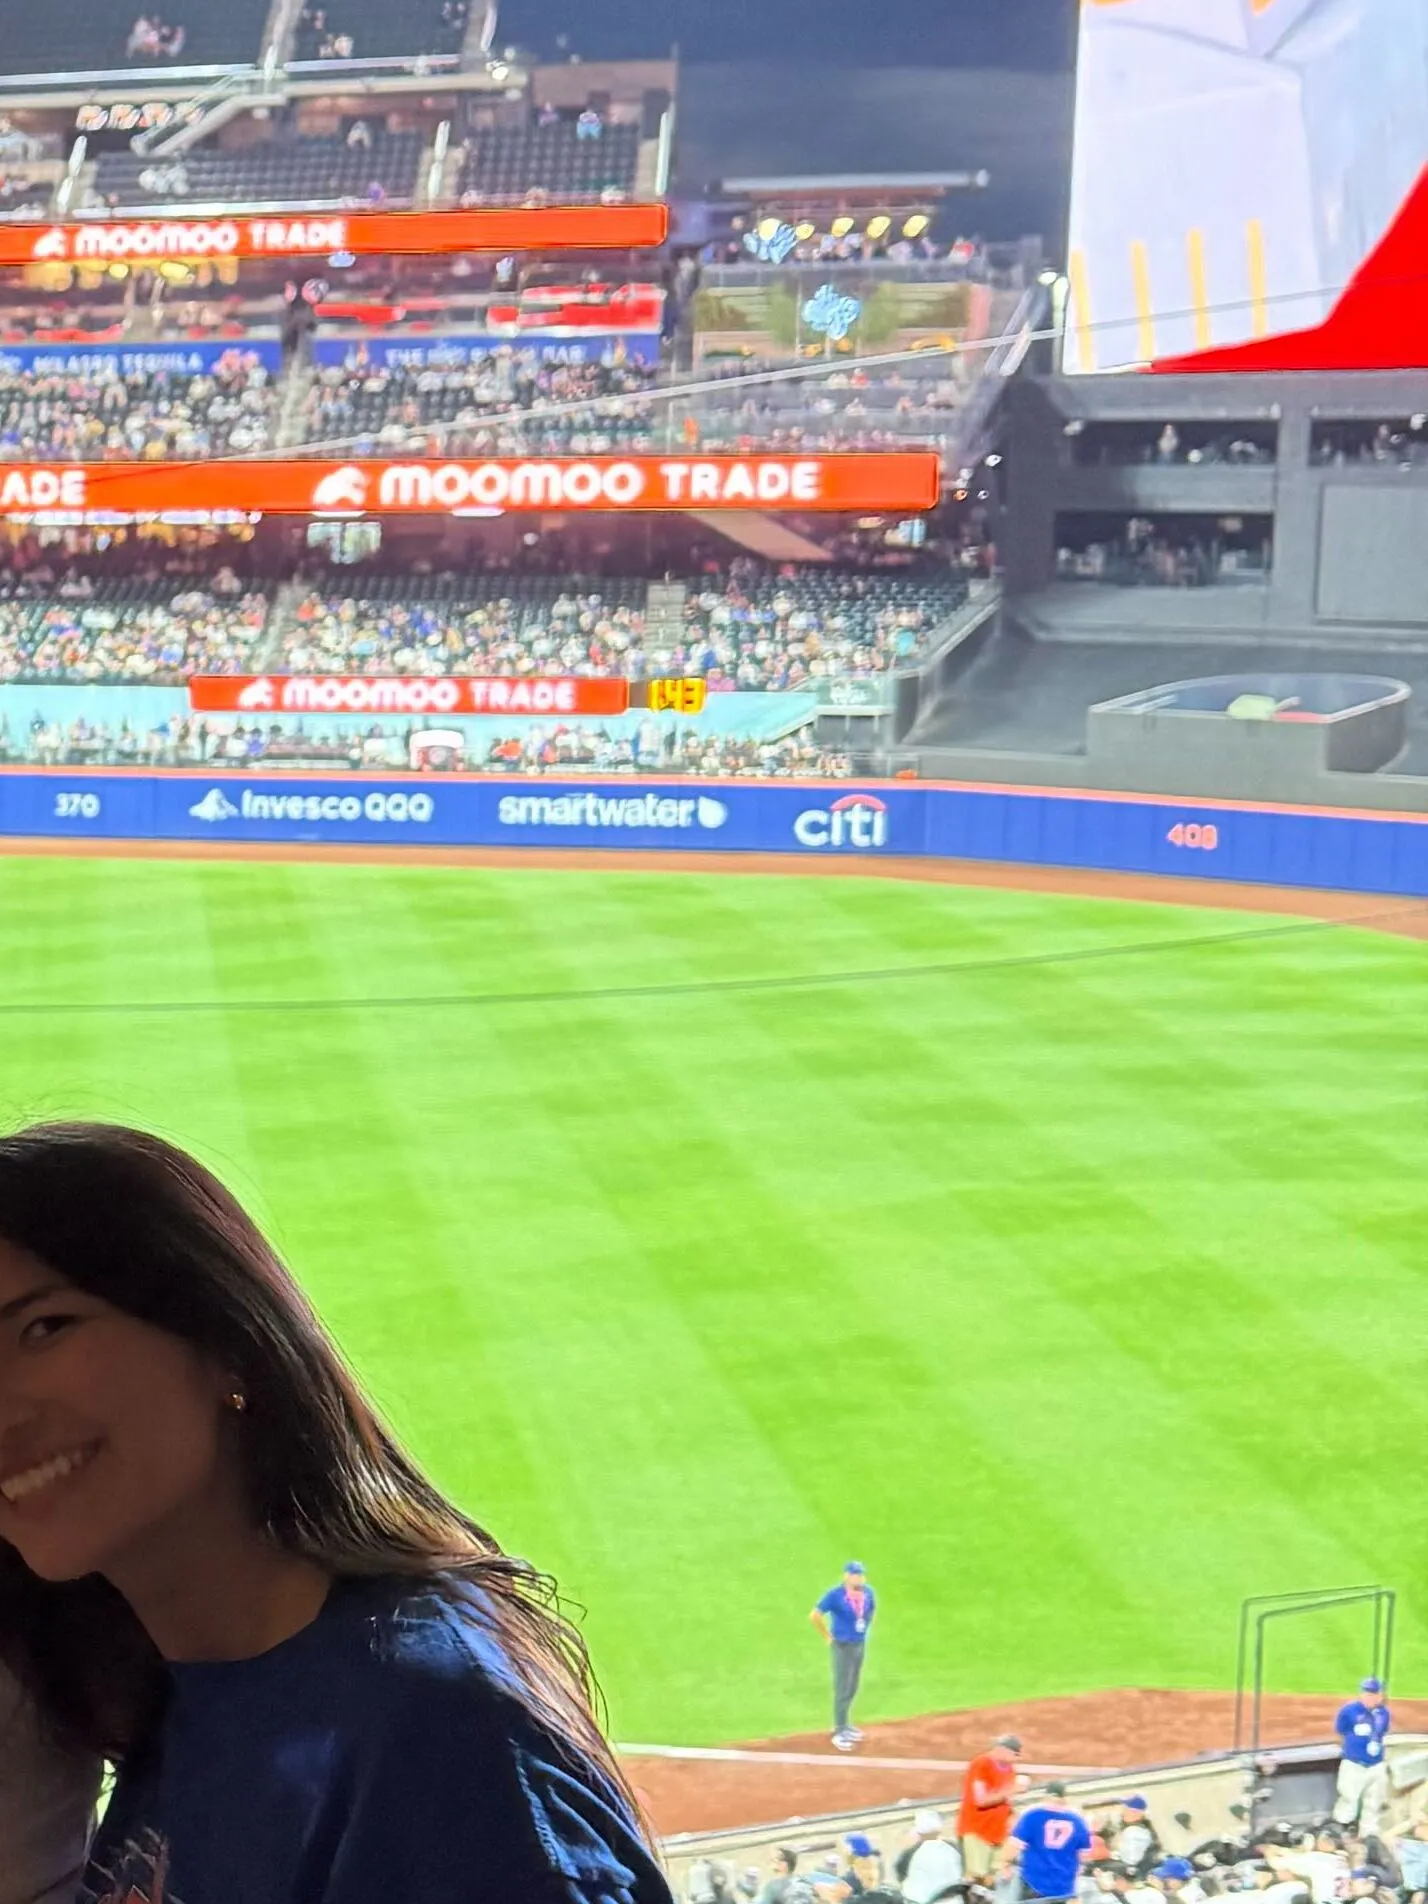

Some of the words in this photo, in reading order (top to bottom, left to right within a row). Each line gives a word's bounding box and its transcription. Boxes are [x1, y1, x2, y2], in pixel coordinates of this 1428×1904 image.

[249, 220, 345, 251] TRADE
[660, 463, 820, 500] TRADE
[470, 680, 574, 710] TRADE
[55, 793, 100, 818] 370
[241, 788, 362, 822] Invesco
[364, 792, 434, 822] QQQ
[498, 791, 696, 828] smartwater
[794, 804, 886, 848] citi
